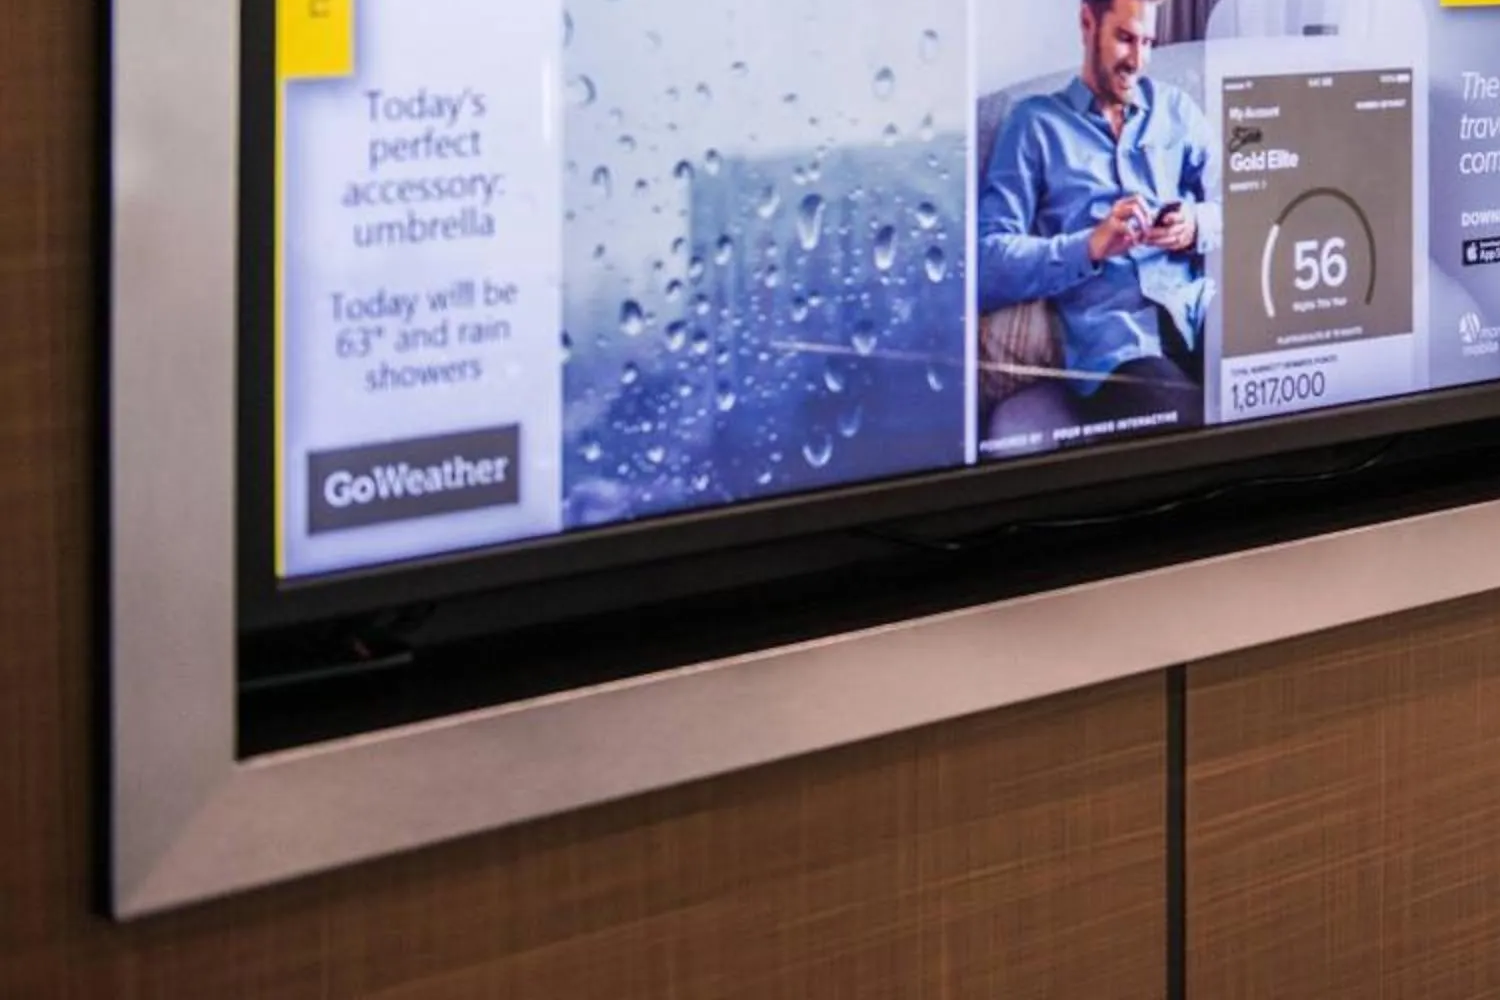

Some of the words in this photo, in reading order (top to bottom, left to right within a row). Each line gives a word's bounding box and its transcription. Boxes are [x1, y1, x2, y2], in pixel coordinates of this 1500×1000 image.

[363, 84, 487, 127] Today's
[1461, 71, 1500, 101] The
[367, 127, 483, 170] perfect
[1229, 151, 1266, 173] Gold
[1268, 148, 1300, 170] Elite
[352, 206, 497, 250] umbrella
[1292, 236, 1348, 292] 56
[330, 289, 420, 326] Today
[424, 279, 476, 313] will
[484, 275, 518, 307] be
[394, 318, 450, 353] and
[458, 312, 511, 347] rain
[364, 353, 483, 393] showers
[1231, 370, 1326, 413] 1,817,000
[323, 450, 510, 508] GoWeather
